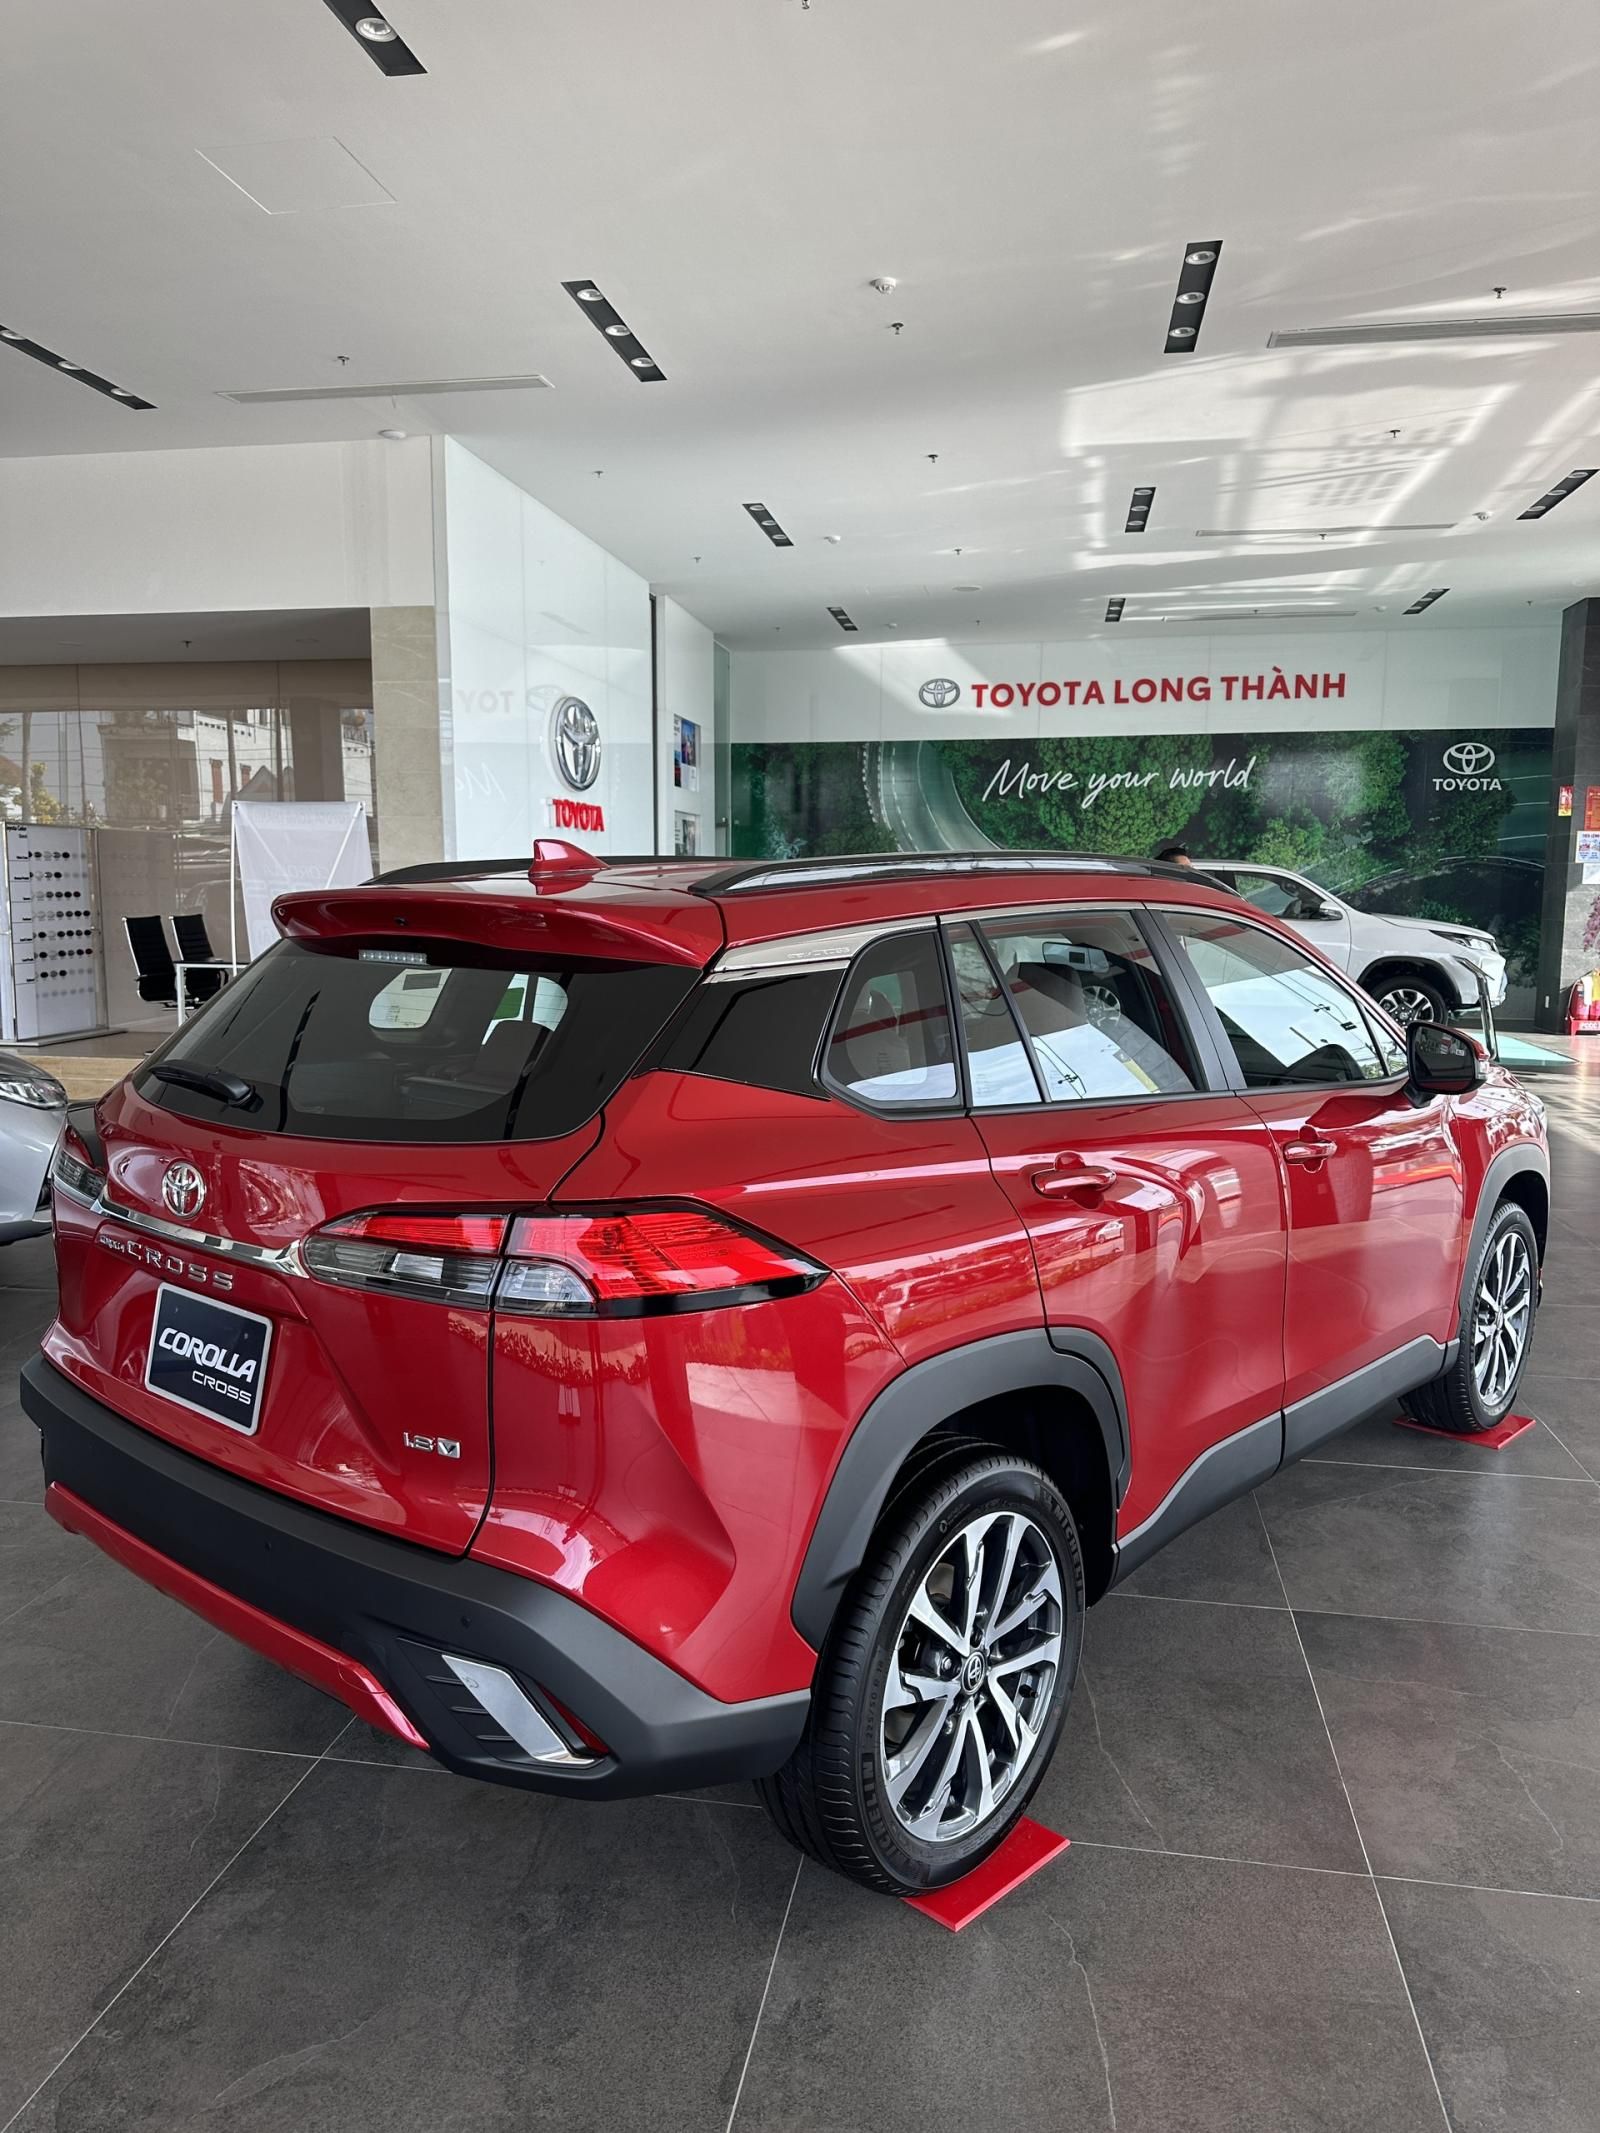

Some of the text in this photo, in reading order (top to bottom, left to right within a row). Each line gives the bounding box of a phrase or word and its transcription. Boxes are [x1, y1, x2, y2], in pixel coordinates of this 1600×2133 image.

[971, 665, 1346, 708] TOYOTA LONG THÀNH
[982, 755, 1257, 809] Move your world
[1432, 778, 1502, 791] TOYOTA
[552, 798, 605, 832] TOYOTA
[127, 1240, 233, 1291] CROSS
[158, 1327, 257, 1383] COROLLA
[192, 1370, 252, 1405] CROSS
